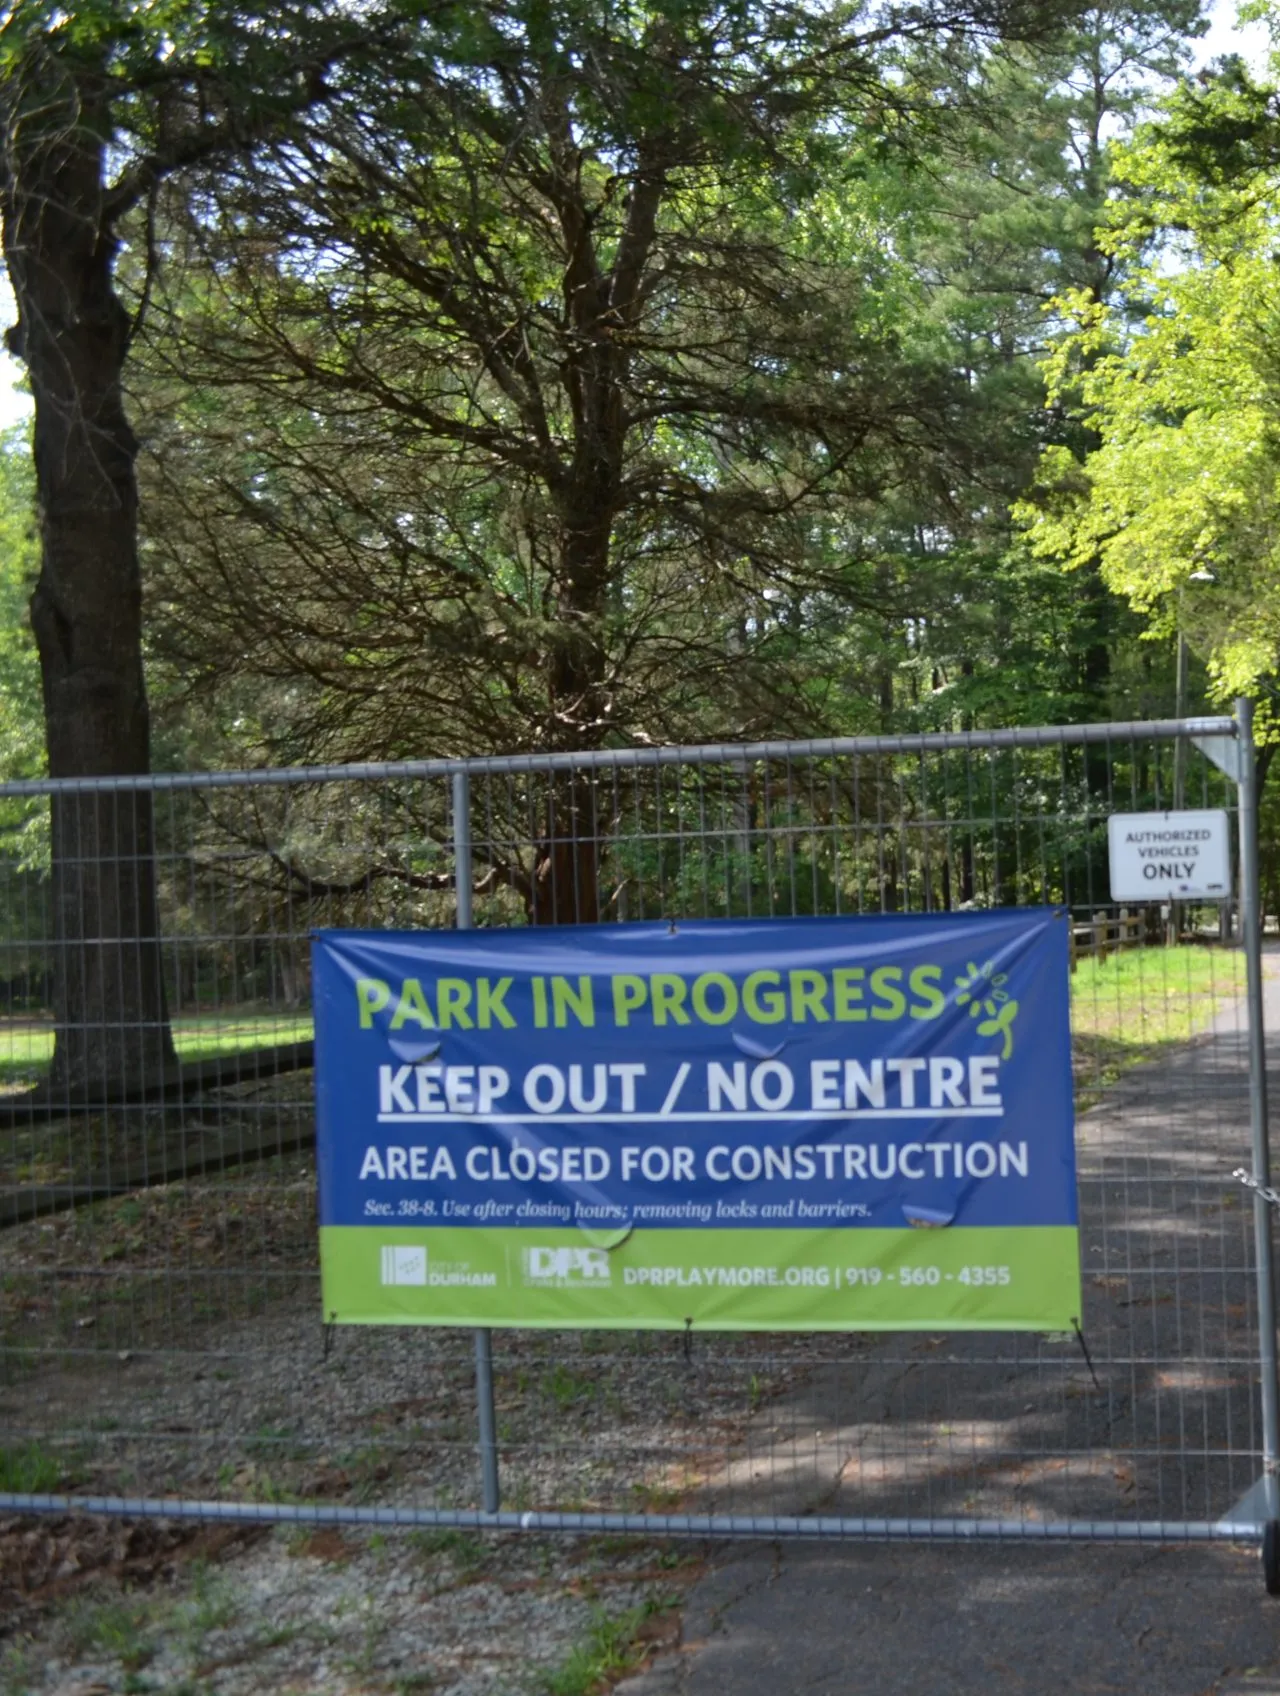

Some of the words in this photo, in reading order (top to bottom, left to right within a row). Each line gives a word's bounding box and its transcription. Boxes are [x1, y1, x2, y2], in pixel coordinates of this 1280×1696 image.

[1125, 829, 1212, 843] AUTHORIZED
[1138, 845, 1199, 858] VEHICLES
[1142, 862, 1195, 880] ONLY
[356, 977, 518, 1030] PARK
[531, 975, 596, 1028] IN
[611, 964, 946, 1027] PROGRESS
[379, 1064, 510, 1114] KEEP
[523, 1062, 647, 1114] OUT
[706, 1059, 795, 1112] NO
[810, 1055, 1002, 1110] ENTRE
[358, 1145, 457, 1181] AREA
[465, 1145, 611, 1182] CLOSED
[621, 1146, 697, 1181] FOR
[705, 1141, 1029, 1182] CONSTRUCTION
[364, 1199, 395, 1217] Sec.
[397, 1199, 438, 1217] 38-8.
[442, 1200, 471, 1217] Use
[473, 1199, 513, 1220] after
[516, 1200, 571, 1221] closing
[574, 1200, 629, 1221] hours;
[632, 1201, 712, 1221] removing
[716, 1200, 757, 1218] locks
[760, 1199, 795, 1218] and
[798, 1200, 872, 1218] barriers.
[529, 1247, 611, 1278] DPR
[429, 1273, 497, 1286] DURHAM
[623, 1265, 829, 1286] DPRPLAYMORE.ORG
[845, 1265, 882, 1286] 919
[899, 1265, 940, 1286] 560
[957, 1265, 1011, 1286] 4355
